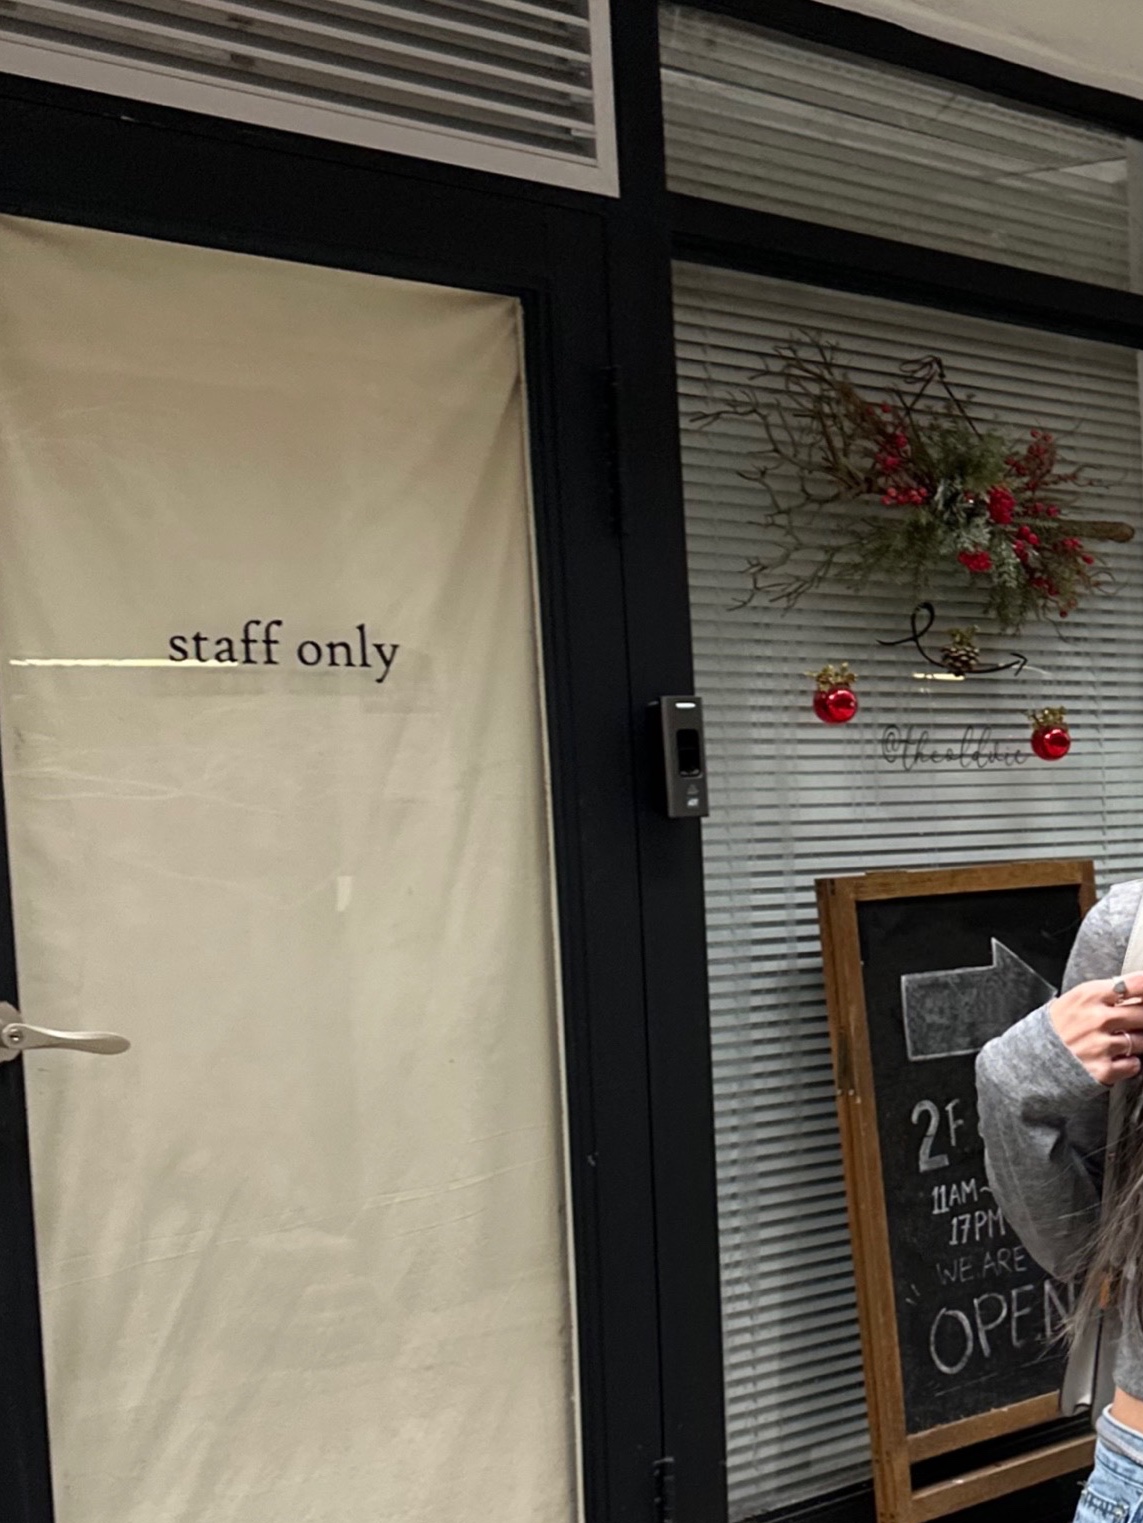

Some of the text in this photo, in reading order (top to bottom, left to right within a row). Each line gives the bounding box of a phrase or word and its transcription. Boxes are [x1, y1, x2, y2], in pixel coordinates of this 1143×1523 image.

[168, 619, 400, 684] staff only
[911, 1098, 964, 1173] 2F
[949, 1206, 1005, 1246] 17PM
[935, 1244, 1028, 1286] WE ARE
[930, 1279, 1077, 1375] OPEN
